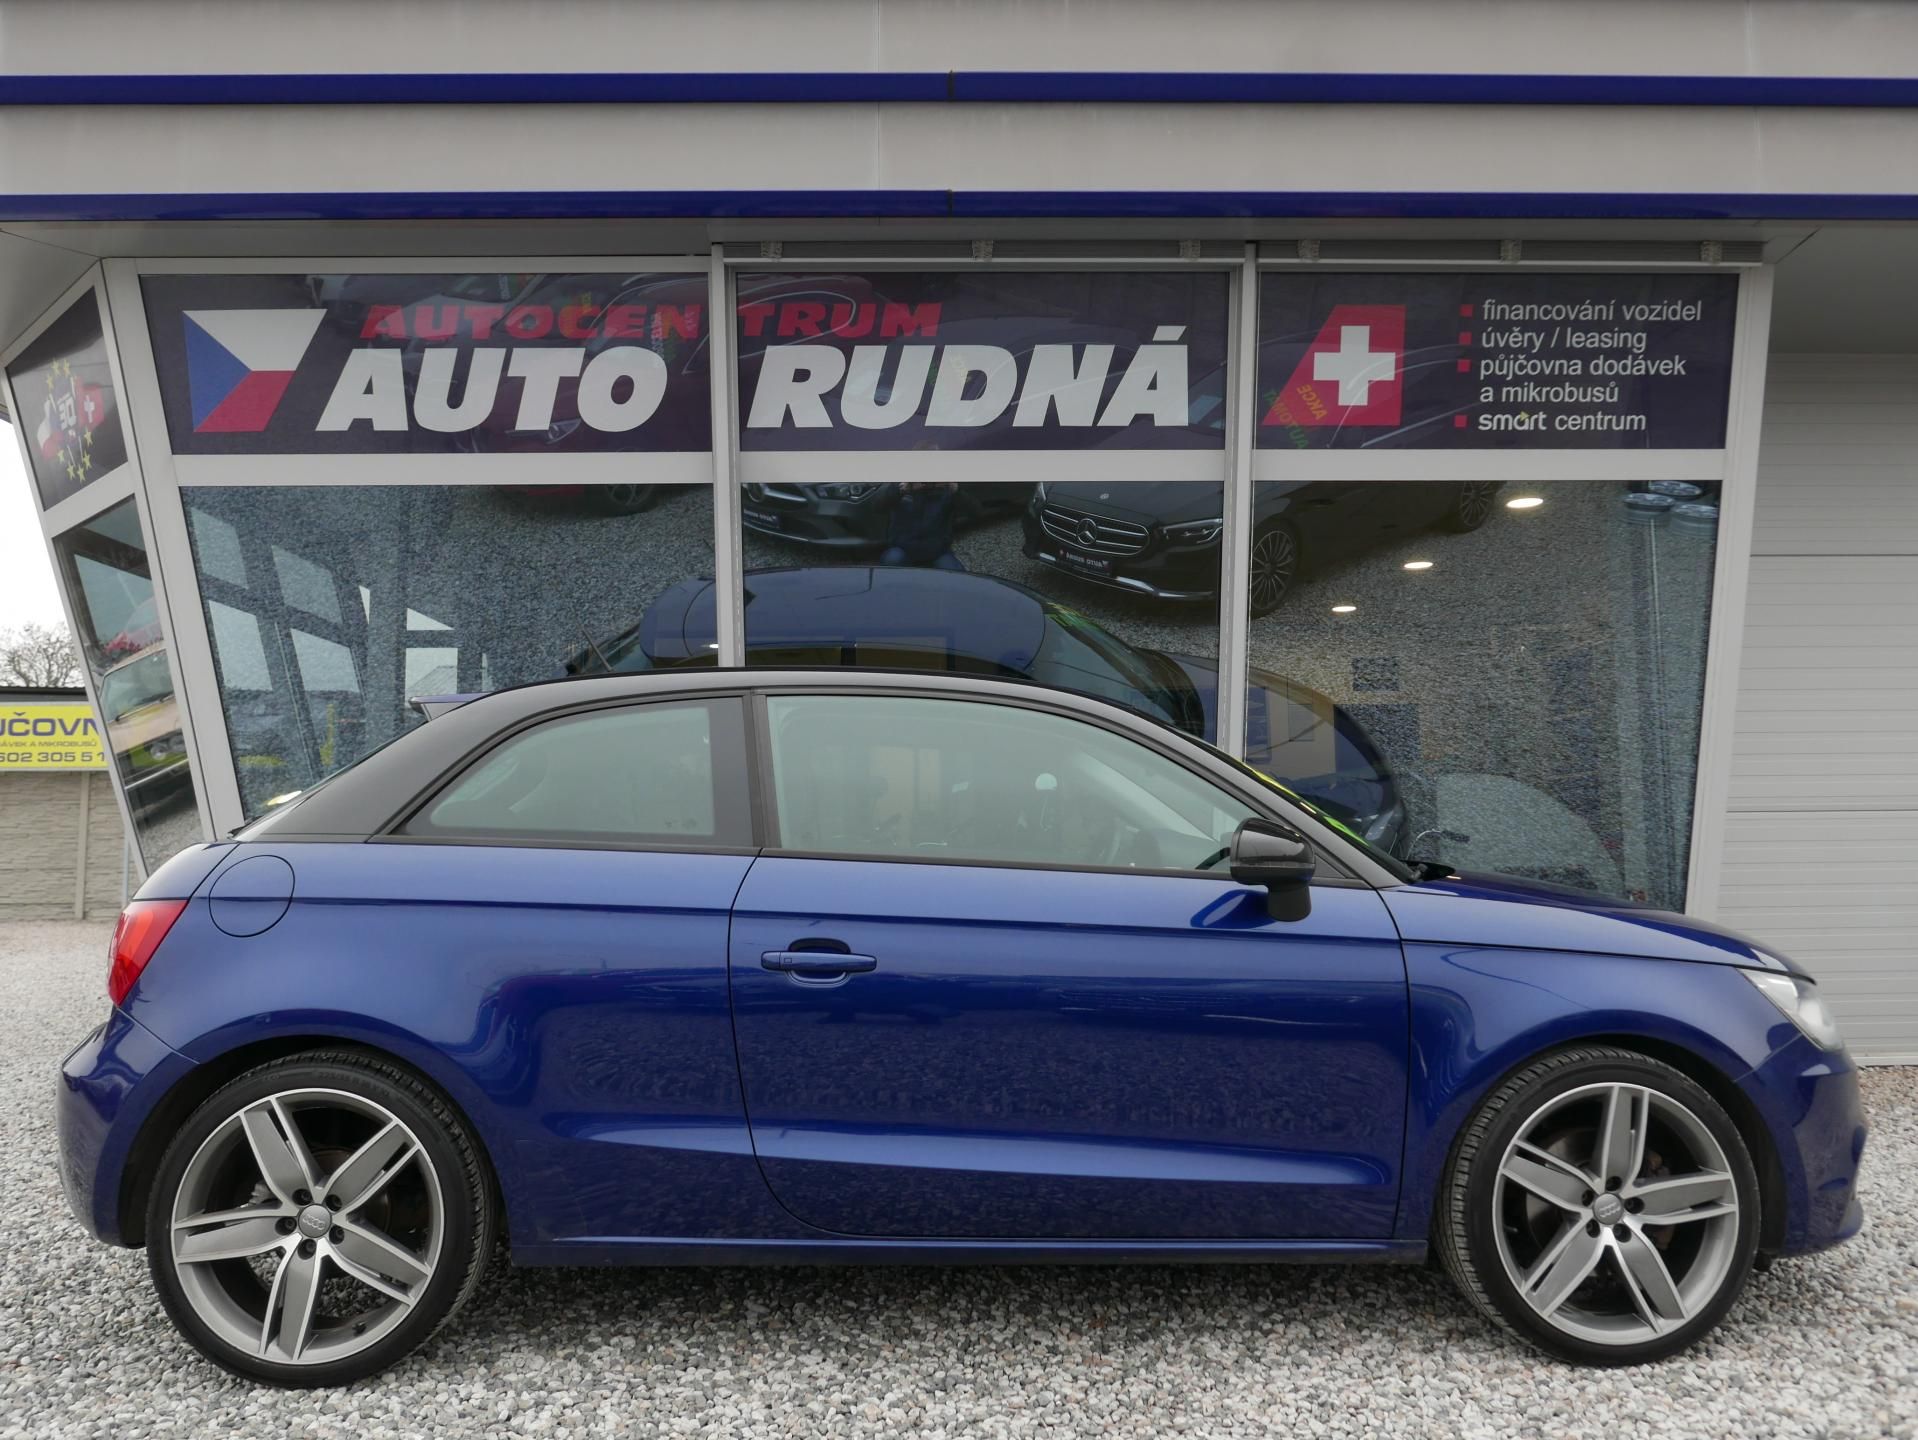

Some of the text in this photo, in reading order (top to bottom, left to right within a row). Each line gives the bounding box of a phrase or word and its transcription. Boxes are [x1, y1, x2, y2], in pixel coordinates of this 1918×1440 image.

[1482, 299, 1702, 321] financování vozidel
[1481, 326, 1545, 353] úvěry
[1565, 327, 1648, 353] leasing
[1479, 354, 1687, 381] půjčovna dodávek
[315, 346, 668, 433] AUTO
[747, 325, 1189, 430] RUDNÁ
[1479, 381, 1620, 403] a mikrobusů
[1478, 411, 1647, 431] smart centrum
[37, 752, 76, 762] 305
